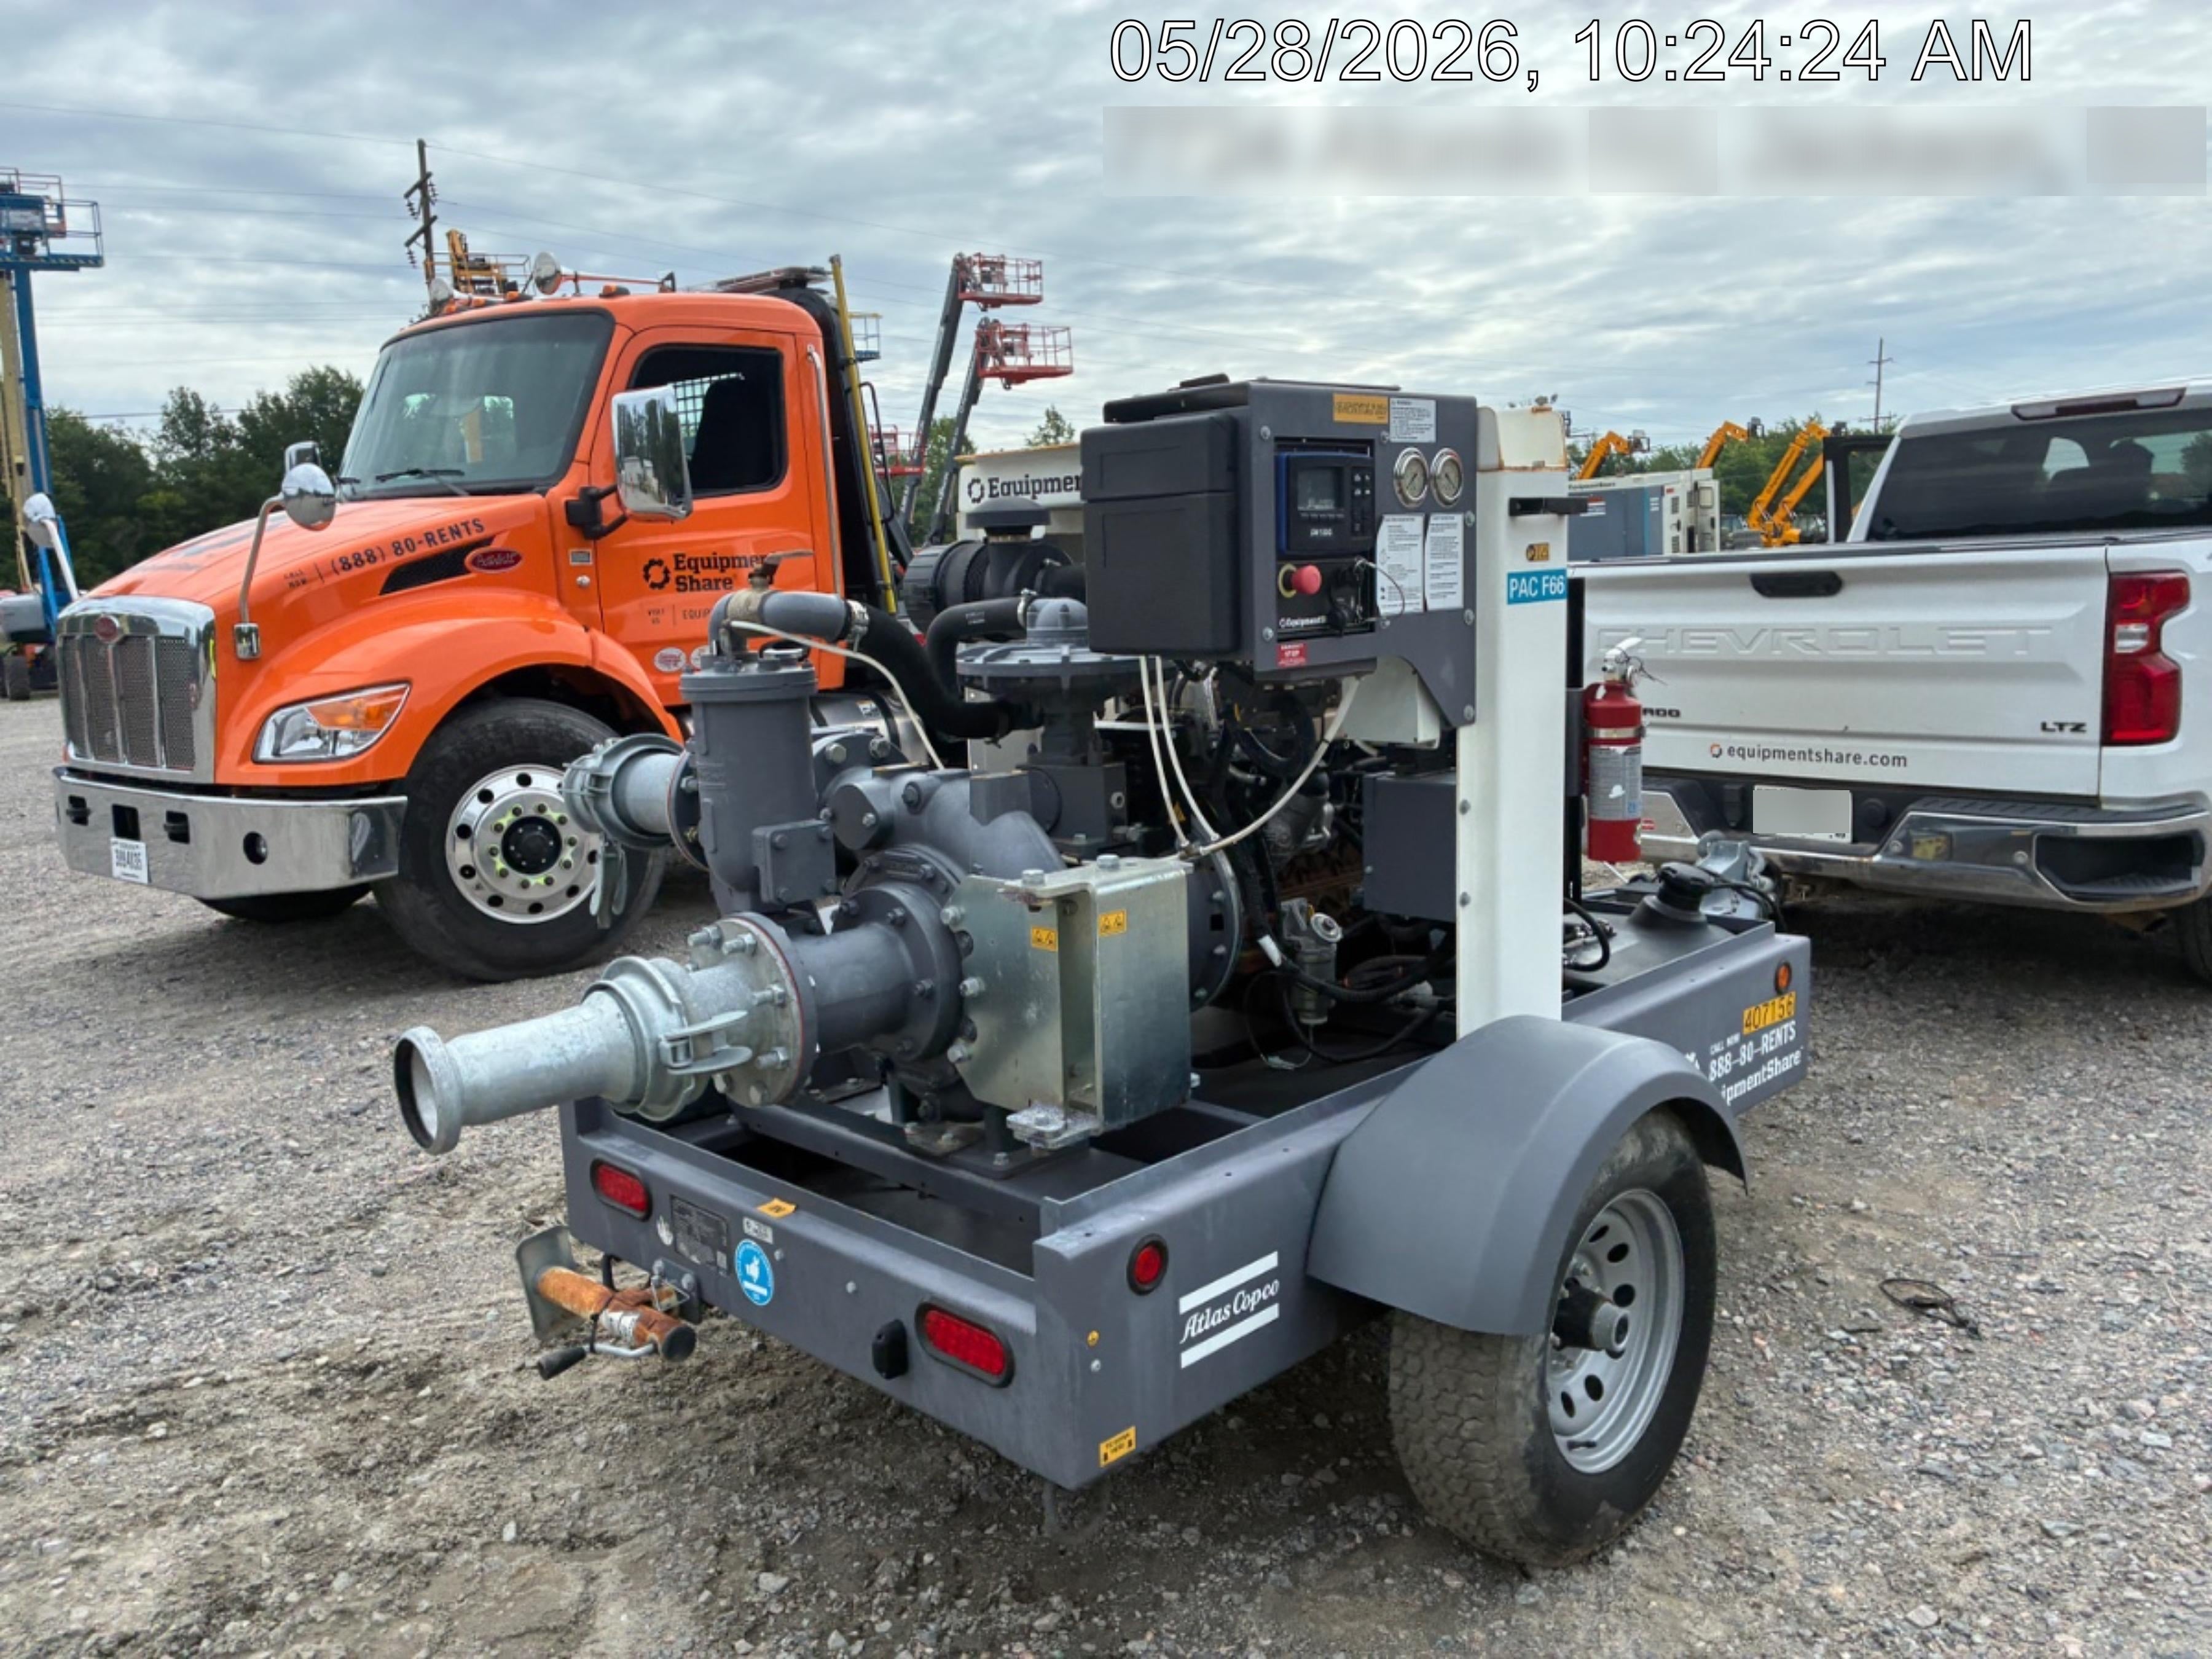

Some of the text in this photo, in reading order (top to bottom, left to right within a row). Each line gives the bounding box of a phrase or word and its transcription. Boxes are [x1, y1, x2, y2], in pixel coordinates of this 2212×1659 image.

[988, 474, 1081, 500] Equipme
[331, 517, 485, 576] (888) 80-RENTS
[673, 552, 767, 571] Equipme
[675, 575, 733, 592] Share
[1509, 574, 1565, 600] PAC F66
[682, 608, 710, 620] EQUIP
[1598, 627, 2053, 656] CHEVROLET
[2040, 721, 2088, 734] LTZ
[1727, 743, 1908, 768] equipmentshare.com
[1721, 1049, 1802, 1107] ipmentShare
[1179, 1278, 1281, 1345] Atlas Copco
